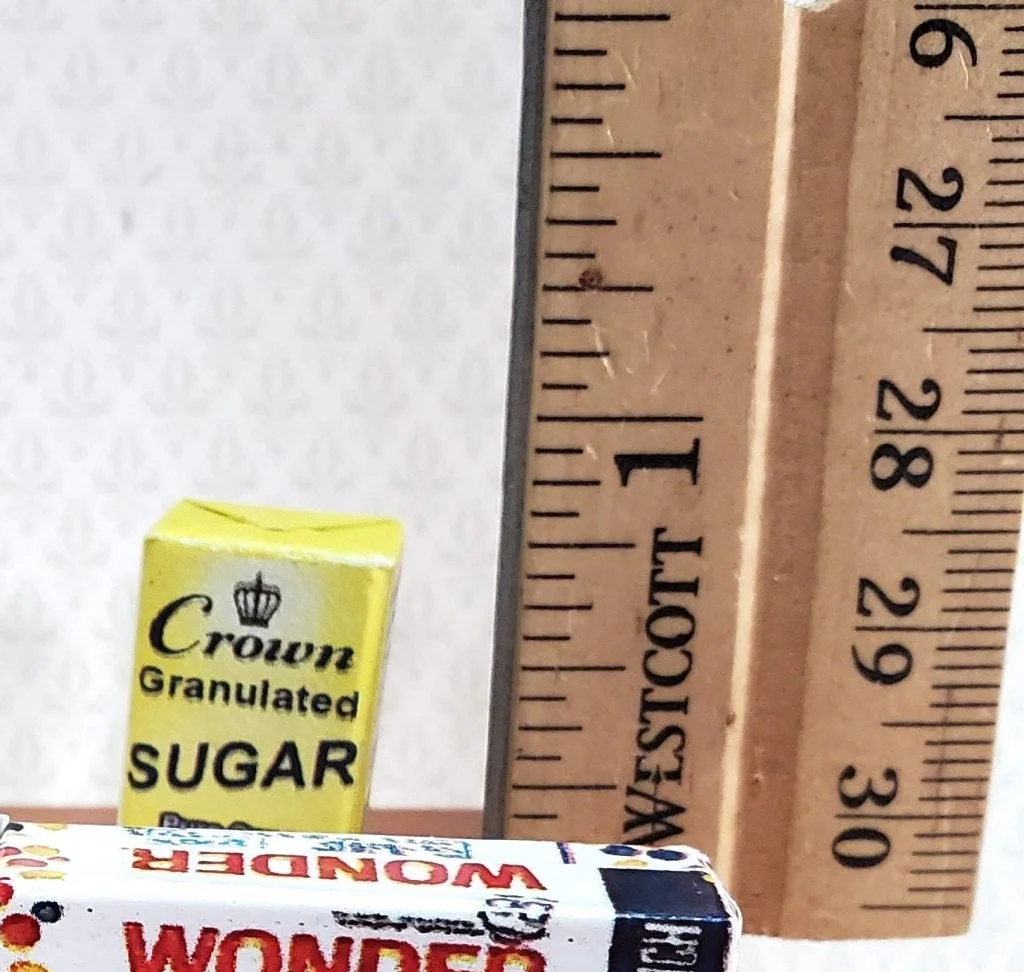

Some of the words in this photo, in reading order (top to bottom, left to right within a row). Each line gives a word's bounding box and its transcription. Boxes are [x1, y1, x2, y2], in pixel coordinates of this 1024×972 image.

[890, 166, 965, 287] 27
[614, 438, 701, 488] 1
[869, 377, 942, 491] 28
[148, 593, 355, 674] Crown
[850, 576, 921, 686] 29
[138, 664, 360, 722] Granulated
[622, 526, 704, 847] WESTCOTT
[127, 739, 359, 792] SUGAR
[831, 763, 900, 869] 30
[131, 847, 548, 891] WONDER
